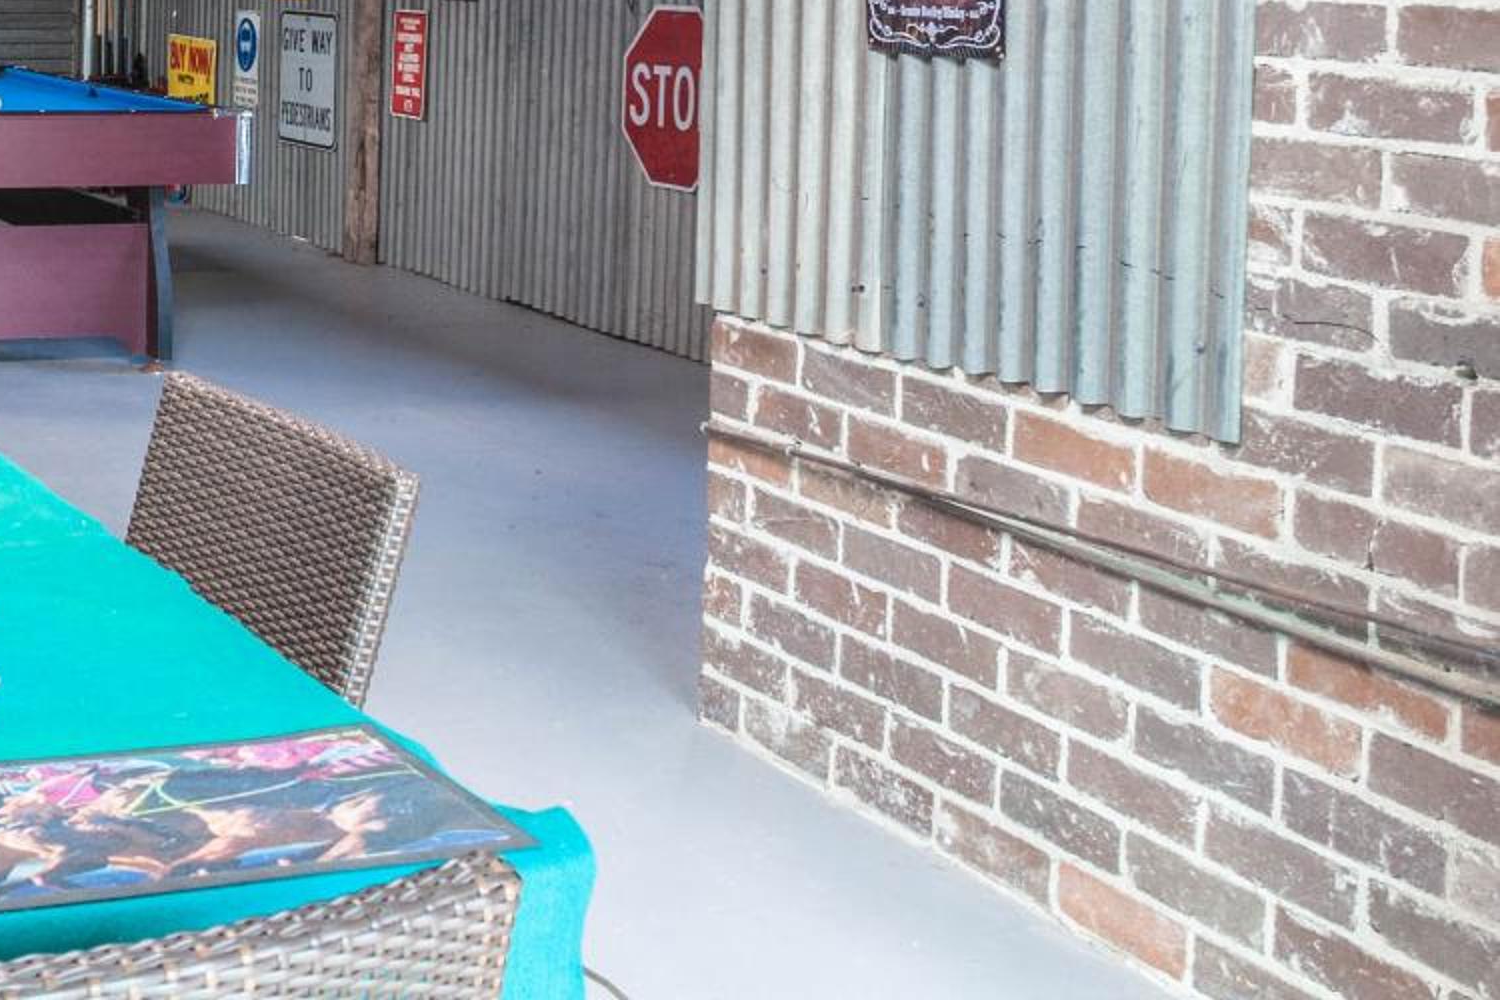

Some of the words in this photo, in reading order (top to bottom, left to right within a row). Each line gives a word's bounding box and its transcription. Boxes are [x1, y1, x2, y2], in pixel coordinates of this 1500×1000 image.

[283, 27, 305, 52] GIVE
[311, 28, 333, 56] WAY
[298, 67, 313, 92] TO
[629, 62, 702, 132] STO
[281, 101, 332, 132] PEDESTRIANS
